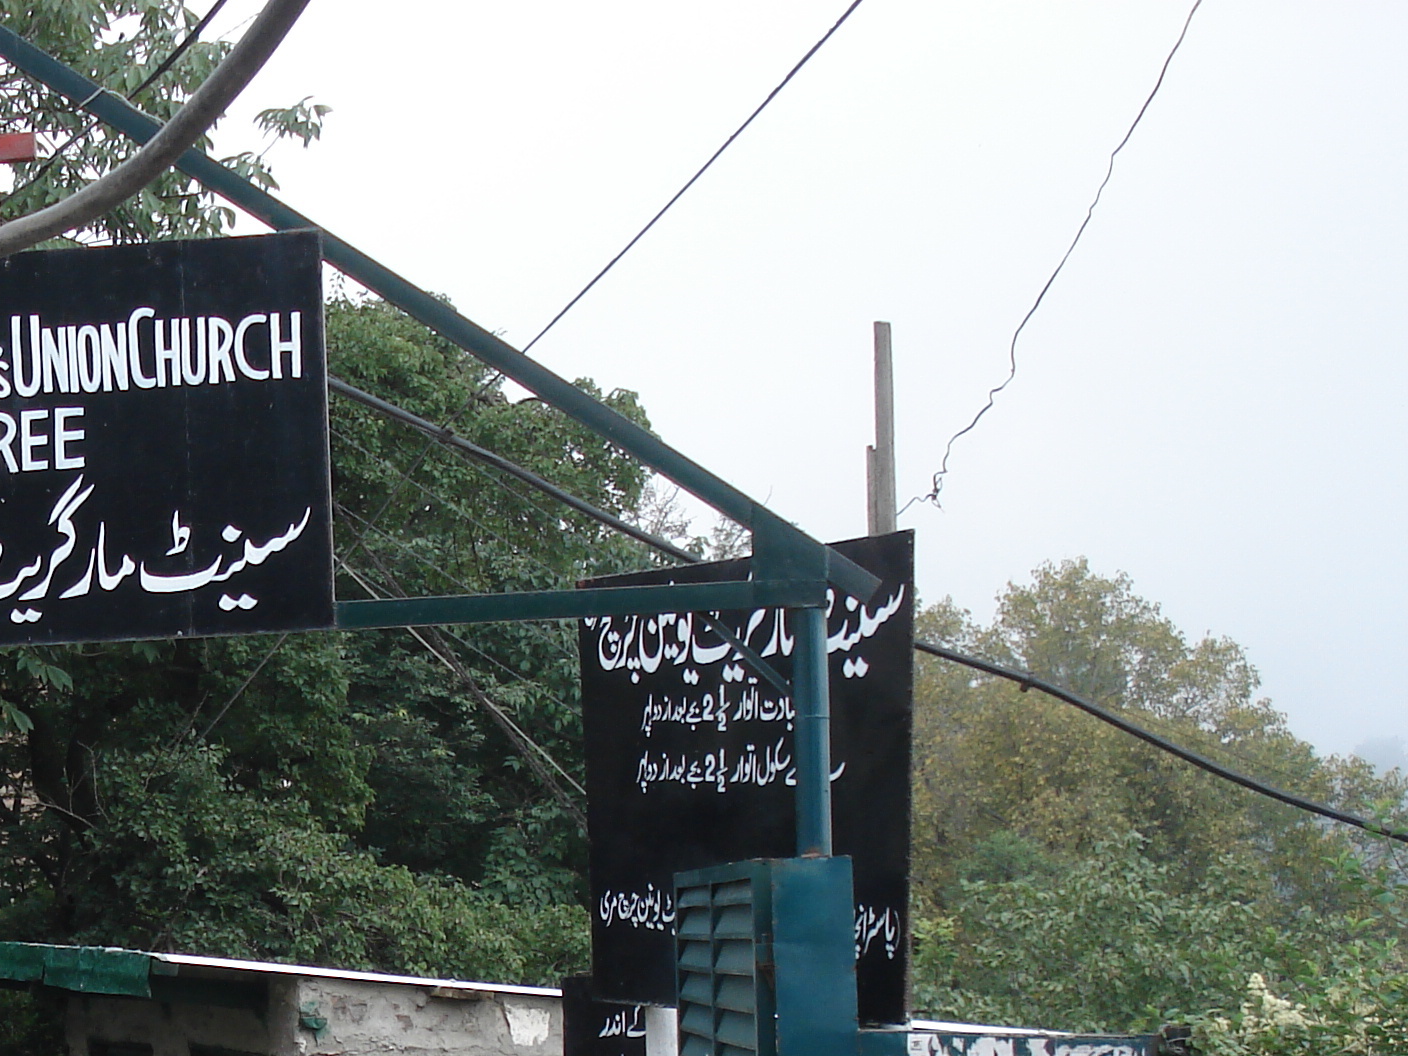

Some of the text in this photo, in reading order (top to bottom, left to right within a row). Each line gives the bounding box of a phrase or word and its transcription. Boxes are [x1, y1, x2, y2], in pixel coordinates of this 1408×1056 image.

[127, 307, 303, 390] CHURCH
[139, 506, 312, 611] سینٹ
[759, 696, 796, 731] بادت
